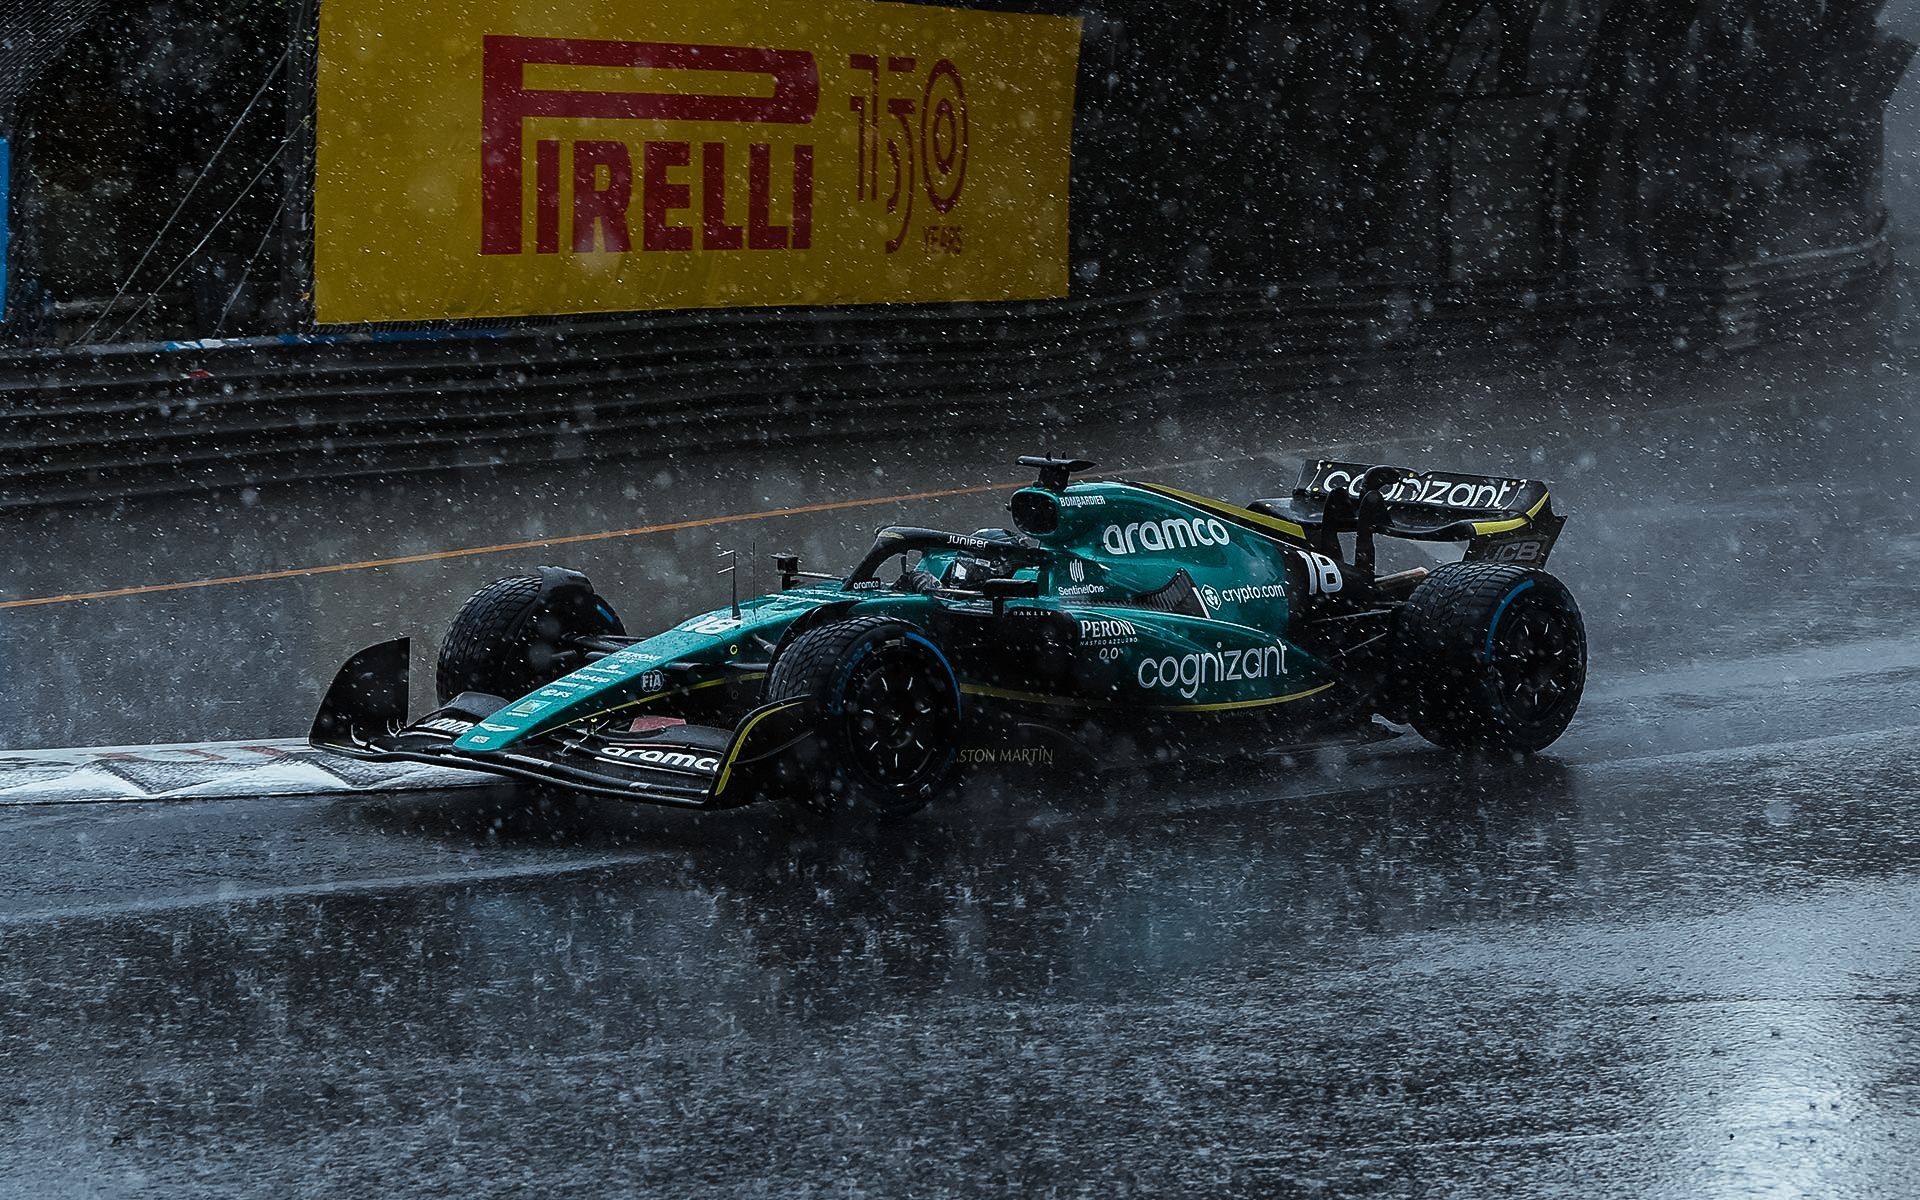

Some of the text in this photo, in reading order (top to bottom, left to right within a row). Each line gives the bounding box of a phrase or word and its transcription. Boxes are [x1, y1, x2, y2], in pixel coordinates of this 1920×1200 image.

[481, 34, 819, 255] PIRELLI
[850, 54, 968, 254] 150
[922, 225, 963, 255] YEARS
[1059, 494, 1106, 508] BOMBARDIER
[1103, 518, 1230, 555] aramco
[1482, 541, 1541, 563] JCB
[1297, 550, 1343, 594] 18
[853, 579, 879, 589] aramco
[1058, 583, 1104, 596] SentinelOne
[1222, 583, 1286, 603] crypto.com
[1080, 619, 1136, 639] PERONI
[1137, 638, 1288, 699] cognizant
[957, 748, 1054, 763] STON MARTIN
